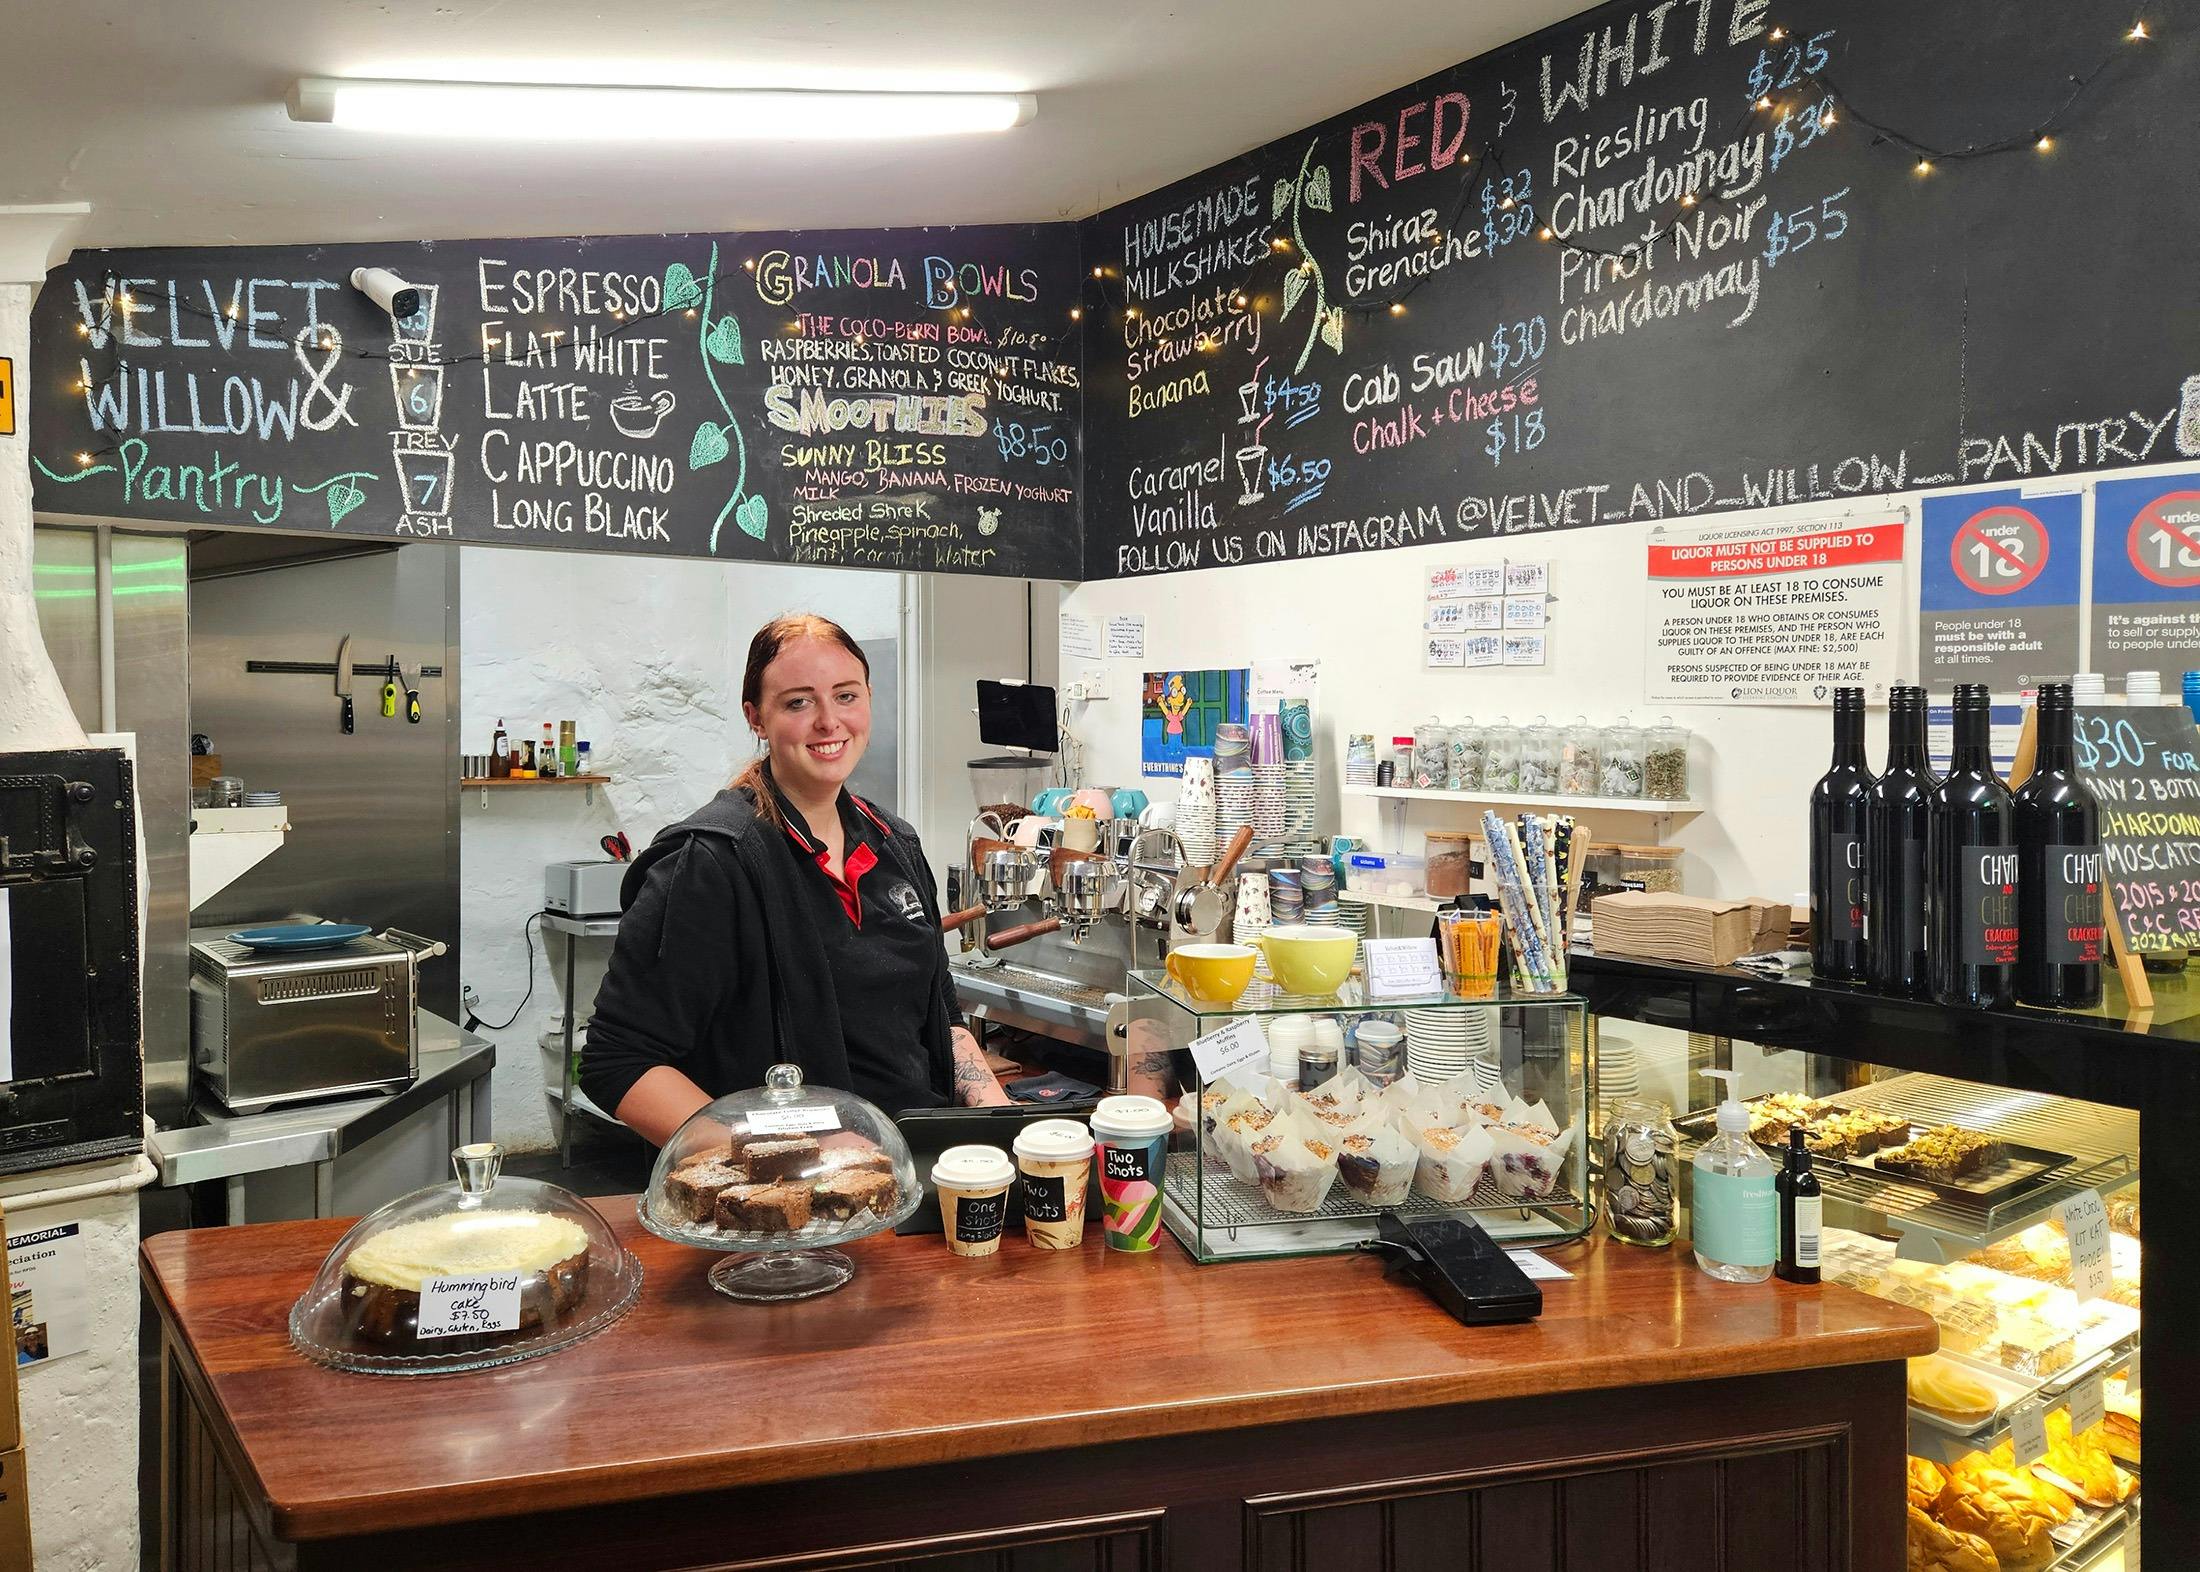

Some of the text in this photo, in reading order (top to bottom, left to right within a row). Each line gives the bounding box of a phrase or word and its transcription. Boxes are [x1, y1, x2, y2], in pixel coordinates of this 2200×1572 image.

[1540, 0, 1772, 125] WHITE
[1553, 29, 1837, 187] Riesling $25
[1349, 92, 1472, 205] RED
[1552, 96, 1835, 240] Chardonnay $30
[1125, 175, 1260, 267] HOUSEMADE
[1346, 169, 1533, 262] Shiraz $32
[1346, 204, 1535, 297] Grenache $30
[1559, 187, 1851, 304] Pinot Noir $55
[756, 250, 1038, 310] GRANOLA BOWLS
[1126, 225, 1272, 303] MILKSHAKES
[479, 257, 661, 317] ESPRESSO
[74, 277, 341, 351] VELVET
[799, 313, 834, 338] THE
[840, 318, 940, 343] COCO-BERRY
[1125, 286, 1244, 349] Chocolate
[388, 344, 443, 364] SUE
[480, 321, 670, 380] FLAT WHITE
[1127, 312, 1261, 381] Strawberry
[294, 322, 359, 431] &
[874, 343, 940, 366] TOASTED
[948, 348, 1020, 378] COCONUT
[1023, 359, 1081, 390] FLAKES,
[1343, 364, 1400, 414] Cab
[1490, 315, 1549, 379] $30
[80, 357, 299, 443] WILLOW
[410, 383, 428, 415] 6
[483, 368, 591, 422] LATTE
[771, 365, 1063, 413] HONEY, GRANOLA GREEK YOGHURT.
[1129, 370, 1322, 418] Banana $4.50
[765, 383, 988, 437] SMOOTHIES
[1353, 377, 1540, 457] Chalk Cheese
[388, 431, 460, 452] TREV
[992, 417, 1068, 465] $8.50
[1485, 407, 1547, 468] $18
[480, 429, 674, 494] CAPPUCCINO
[782, 440, 946, 473] SUNNY BLISS
[1129, 433, 1332, 500] Caramel $6.50
[119, 437, 284, 525] Pantry
[414, 475, 438, 506] 7
[793, 486, 840, 500] MILK
[805, 469, 1073, 503] MANGO, BANANA, FROZEN YOGHURT
[396, 514, 454, 537] ASH
[492, 489, 670, 543] LONG BLACK
[791, 503, 863, 526] Shreded
[1133, 489, 1218, 538] Vanilla
[1117, 540, 1200, 573] FOLLOW
[1212, 536, 1244, 564] US
[1255, 529, 1285, 559] ON
[1297, 505, 1447, 556] INSTAGRAM
[1671, 533, 1874, 560] LIQUOR MUST NOT BE SUPPLIED TO
[1699, 521, 1842, 541] LIQUOR LICENSING ACT 1997, SECTION 113
[1980, 524, 2020, 538] under
[1711, 553, 1827, 572] PERSONS UNDER 18
[1970, 538, 2025, 578] 18
[1662, 576, 1883, 598] YOU MUST BE AT LEAST 18 TO CONSUME
[1691, 591, 1848, 609] LIQUOR ON THESE PREMISES.
[1935, 618, 2022, 632] People under 18
[1935, 630, 2027, 642] must be with a
[2108, 628, 2120, 638] to
[2123, 627, 2143, 638] sell
[2145, 628, 2159, 637] or
[2133, 613, 2186, 627] against
[1934, 653, 1994, 665] at all times.
[1935, 641, 2043, 654] responsible adult
[2108, 638, 2164, 651] to people
[2161, 750, 2200, 771] FOR
[2132, 778, 2147, 801] 2
[2116, 881, 2165, 911] 2015
[2128, 912, 2142, 935] C
[2155, 913, 2172, 935] C
[2131, 930, 2171, 951] 2022
[1196, 1032, 1220, 1046] Blueberry
[1226, 1019, 1250, 1033] Raspberry
[1216, 1033, 1236, 1045] Muffins
[1107, 1150, 1134, 1164] Two
[1107, 1162, 1144, 1177] Shots
[968, 1202, 996, 1213] One
[431, 1276, 518, 1300] Hummingbird
[420, 1325, 447, 1336] Dairy,
[481, 1320, 501, 1330] Eggs
[449, 1309, 490, 1321] $7.50
